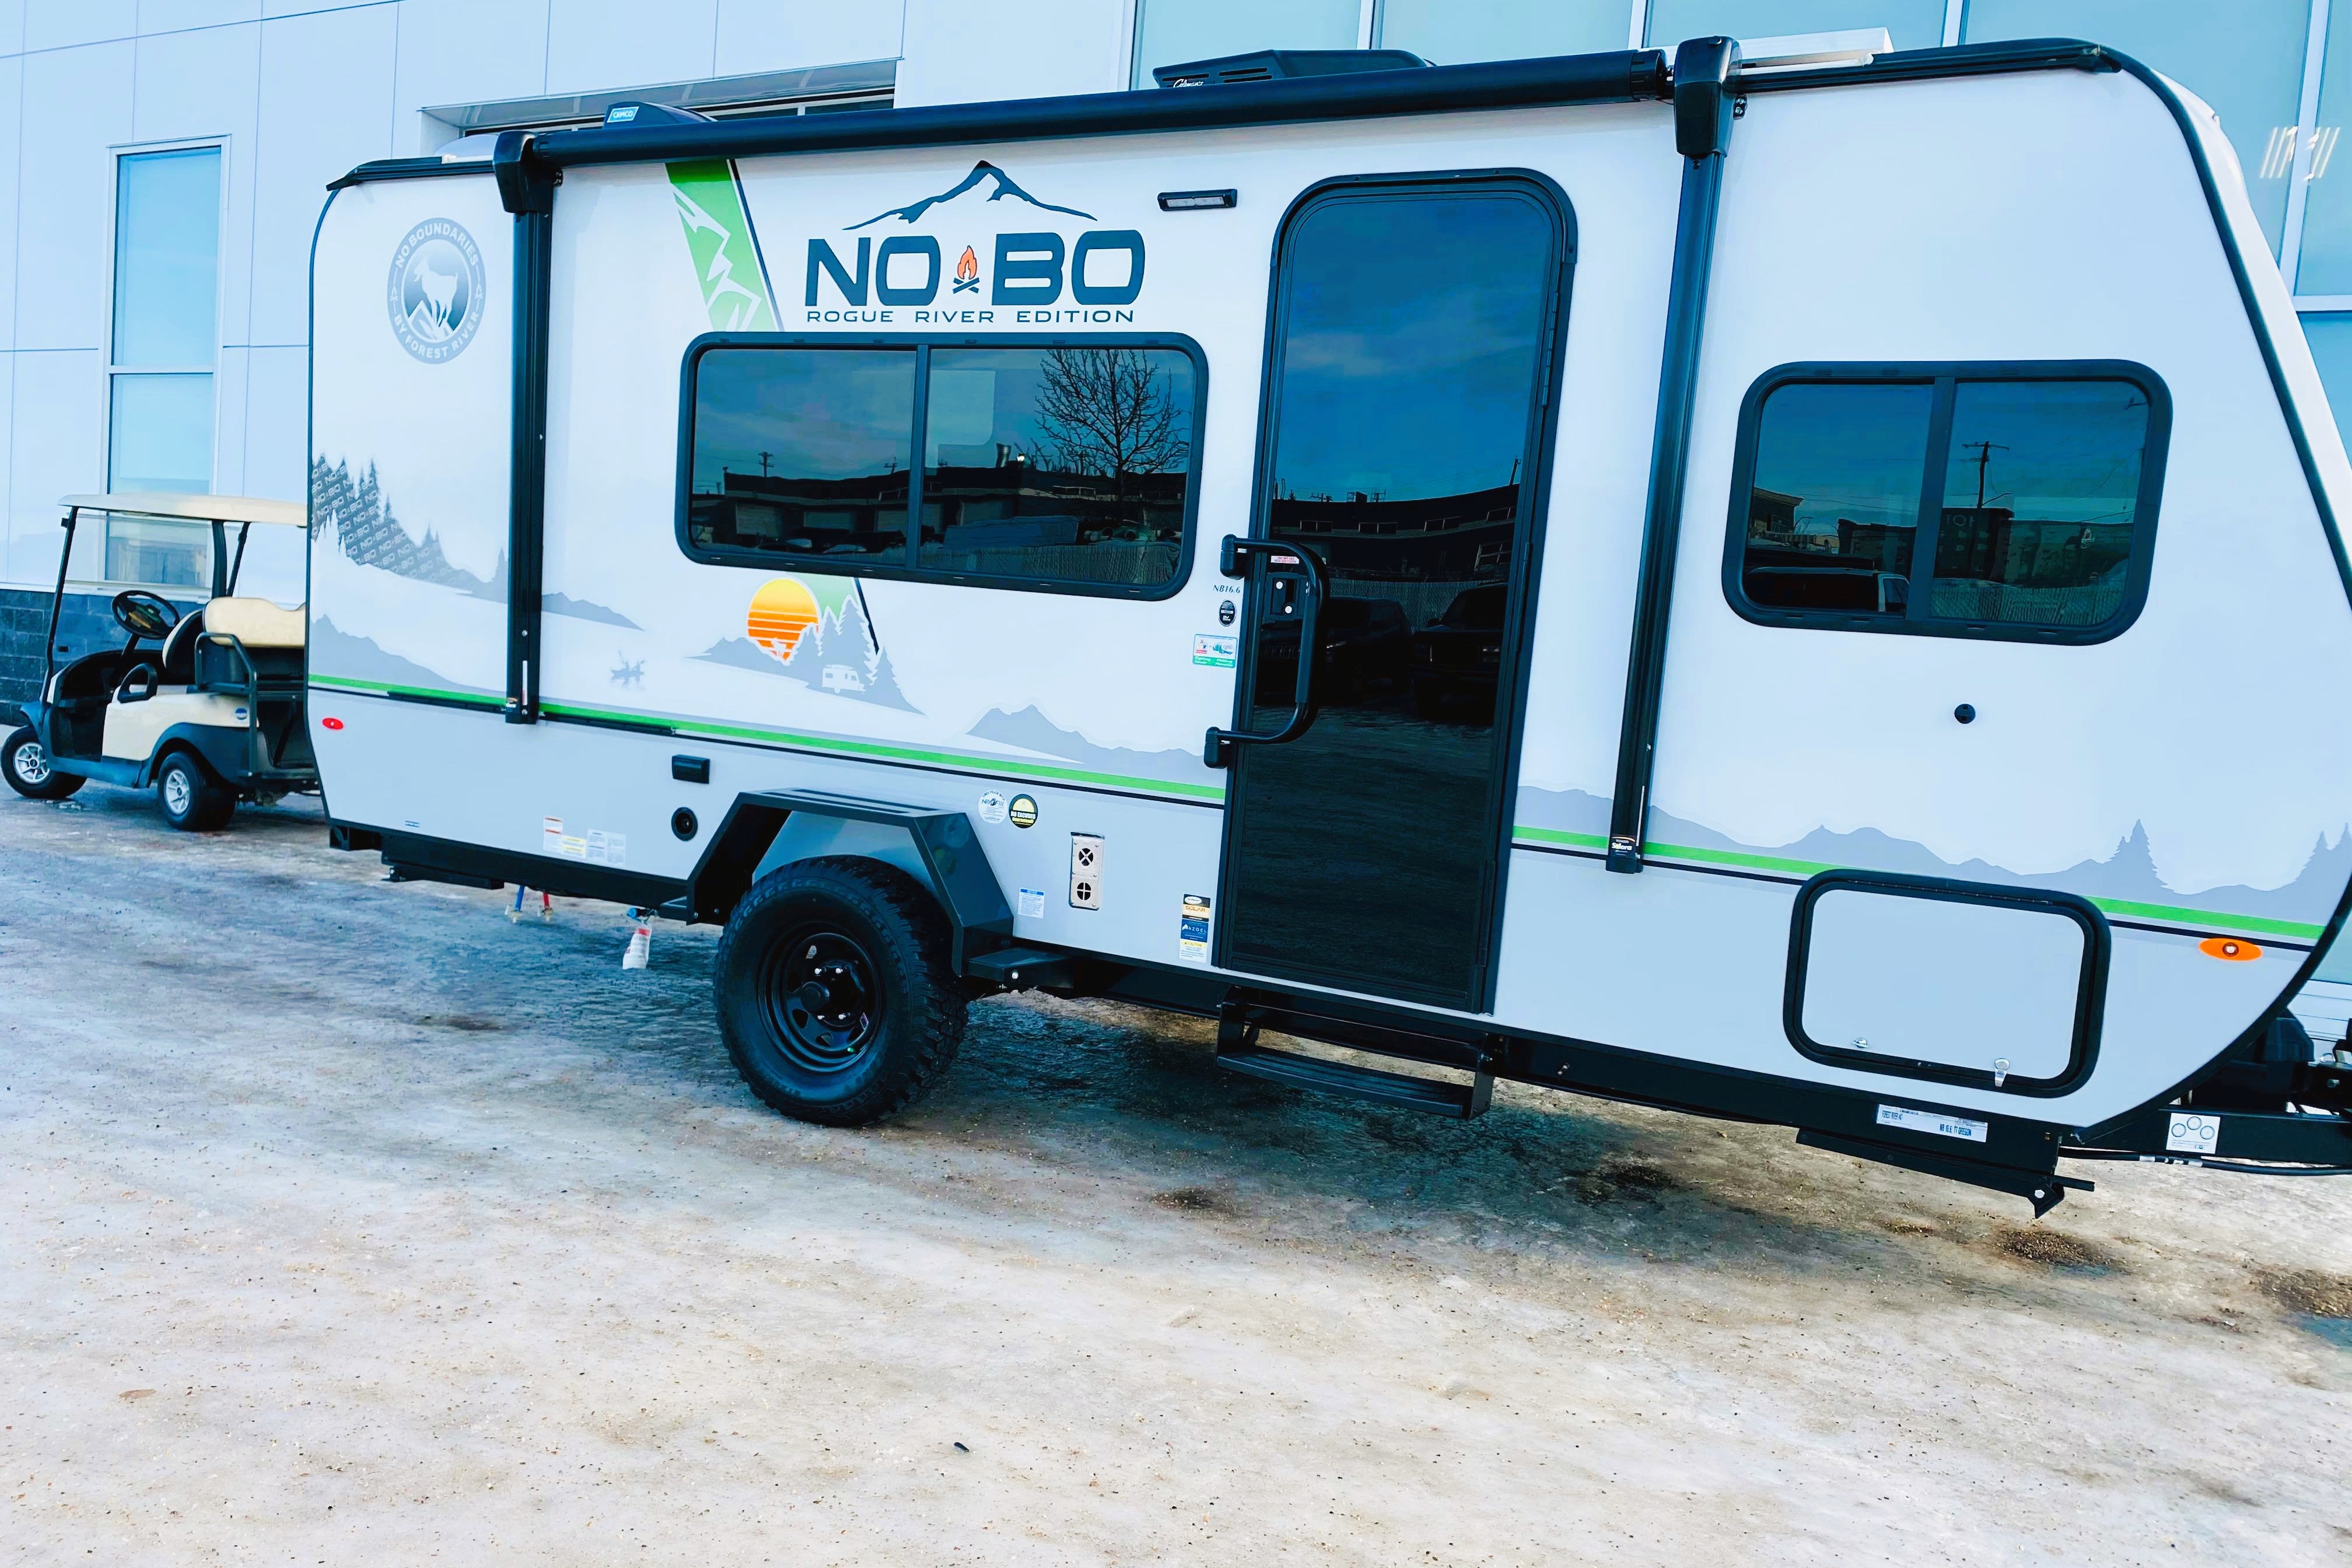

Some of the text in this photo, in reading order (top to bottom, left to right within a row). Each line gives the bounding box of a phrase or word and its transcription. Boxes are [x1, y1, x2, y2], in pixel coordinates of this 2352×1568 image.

[396, 222, 480, 268] NO BOUNDARIES
[807, 310, 1134, 323] ROGUE RIVER EDITION
[394, 312, 480, 359] BY FOREST RIVER
[1213, 584, 1241, 594] NB16.6
